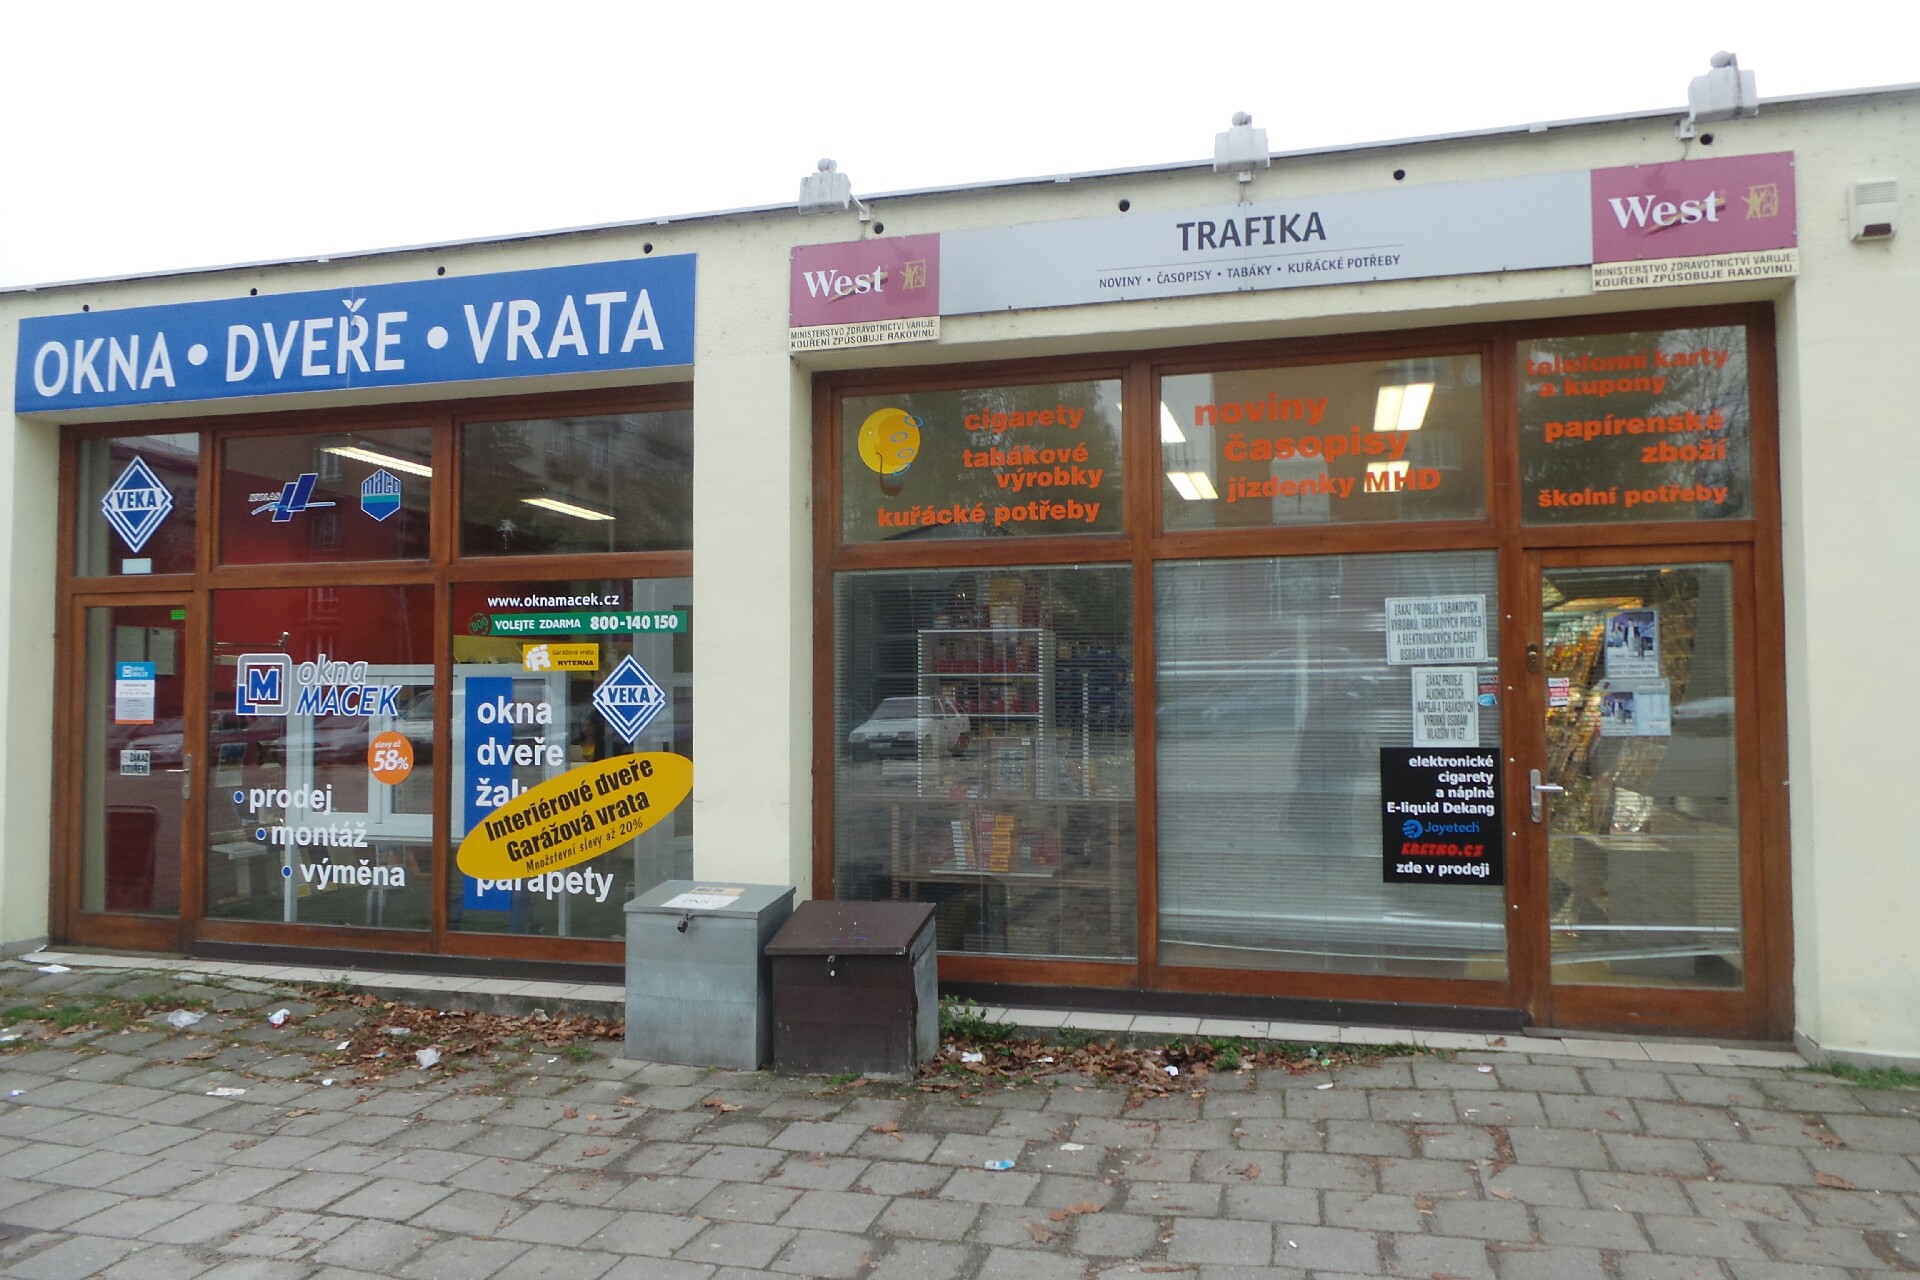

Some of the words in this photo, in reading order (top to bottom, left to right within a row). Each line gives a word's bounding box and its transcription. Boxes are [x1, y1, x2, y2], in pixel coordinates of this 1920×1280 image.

[1608, 191, 1719, 229] West
[1176, 211, 1327, 251] TRAFIKA
[1099, 275, 1142, 288] NOVINY
[1156, 269, 1212, 285] ČASOPISY
[1227, 264, 1272, 279] TABÁKY
[1287, 256, 1344, 274] KUŘÁCKÉ
[1347, 253, 1401, 269] POTŘEBY
[1594, 263, 1668, 277] MINISTERSTVO
[1670, 257, 1751, 271] ZDRAVOTNICTVÍ
[1594, 273, 1649, 288] KOUŘENÍ
[1652, 269, 1723, 283] ZPŮSOBUJE
[803, 265, 884, 298] West
[34, 332, 176, 397] OKNA
[226, 298, 408, 382] DVEŘE
[464, 288, 664, 364] VRATA
[790, 327, 845, 340] MINISTERSTVO
[846, 322, 905, 335] ZDRAVOTNICTVÍ
[790, 337, 831, 349] KOUŘENÍ
[832, 333, 884, 345] ZPŮSOBUJE
[1653, 347, 1729, 368] karty
[1539, 382, 1556, 397] a
[1563, 375, 1667, 398] kupony
[963, 404, 1085, 433] cigarety
[1194, 392, 1329, 426] noviny
[1544, 408, 1725, 442] papírenské
[962, 441, 1089, 469] tabákové
[1223, 425, 1411, 463] časopisy
[1641, 438, 1727, 464] zboží
[995, 465, 1103, 492] výrobky
[1227, 473, 1356, 503] jízdenky
[1366, 468, 1442, 492] MHD
[115, 490, 159, 508] VEKA
[1538, 486, 1618, 508] školní
[1624, 483, 1729, 508] potřeby
[877, 501, 987, 527] kuřácké
[994, 498, 1100, 526] potřeby
[487, 592, 620, 608] www.oknamacek.cz
[1414, 602, 1439, 615] PRODEJE
[495, 619, 535, 632] VOLEJTE
[539, 618, 581, 630] ZDARMA
[590, 614, 651, 630] 800-140
[654, 614, 678, 629] 150
[1397, 633, 1402, 645] A
[1453, 631, 1477, 644] CIGARET
[1456, 647, 1464, 658] 18
[1465, 646, 1475, 658] LET
[297, 653, 368, 686] okna
[294, 684, 403, 717] MACEK
[607, 687, 651, 704] VEKA
[477, 696, 552, 724] okna
[374, 741, 392, 750] slevy
[393, 739, 402, 748] až
[477, 737, 563, 766] dveře
[373, 750, 409, 772] 58%
[1408, 754, 1494, 768] elektronické
[1438, 770, 1494, 785] cigarety
[249, 784, 333, 815] prodej
[484, 780, 594, 842] Interiérové
[595, 758, 654, 797] dveře
[1435, 788, 1444, 798] a
[1447, 785, 1495, 800] náplně
[1387, 801, 1439, 815] E-liquid
[1443, 802, 1495, 817] Dekang
[271, 821, 369, 848] montáž
[506, 811, 595, 863] Garážová
[595, 791, 651, 828] vrata
[1425, 821, 1480, 835] Joyetech
[526, 843, 576, 873] Množstevní
[580, 834, 602, 853] slevy
[605, 826, 616, 843] až
[620, 816, 644, 836] 20%
[300, 857, 406, 890] výměna
[1396, 861, 1422, 874] zde
[1425, 863, 1435, 874] v
[1438, 862, 1490, 878] prodeji
